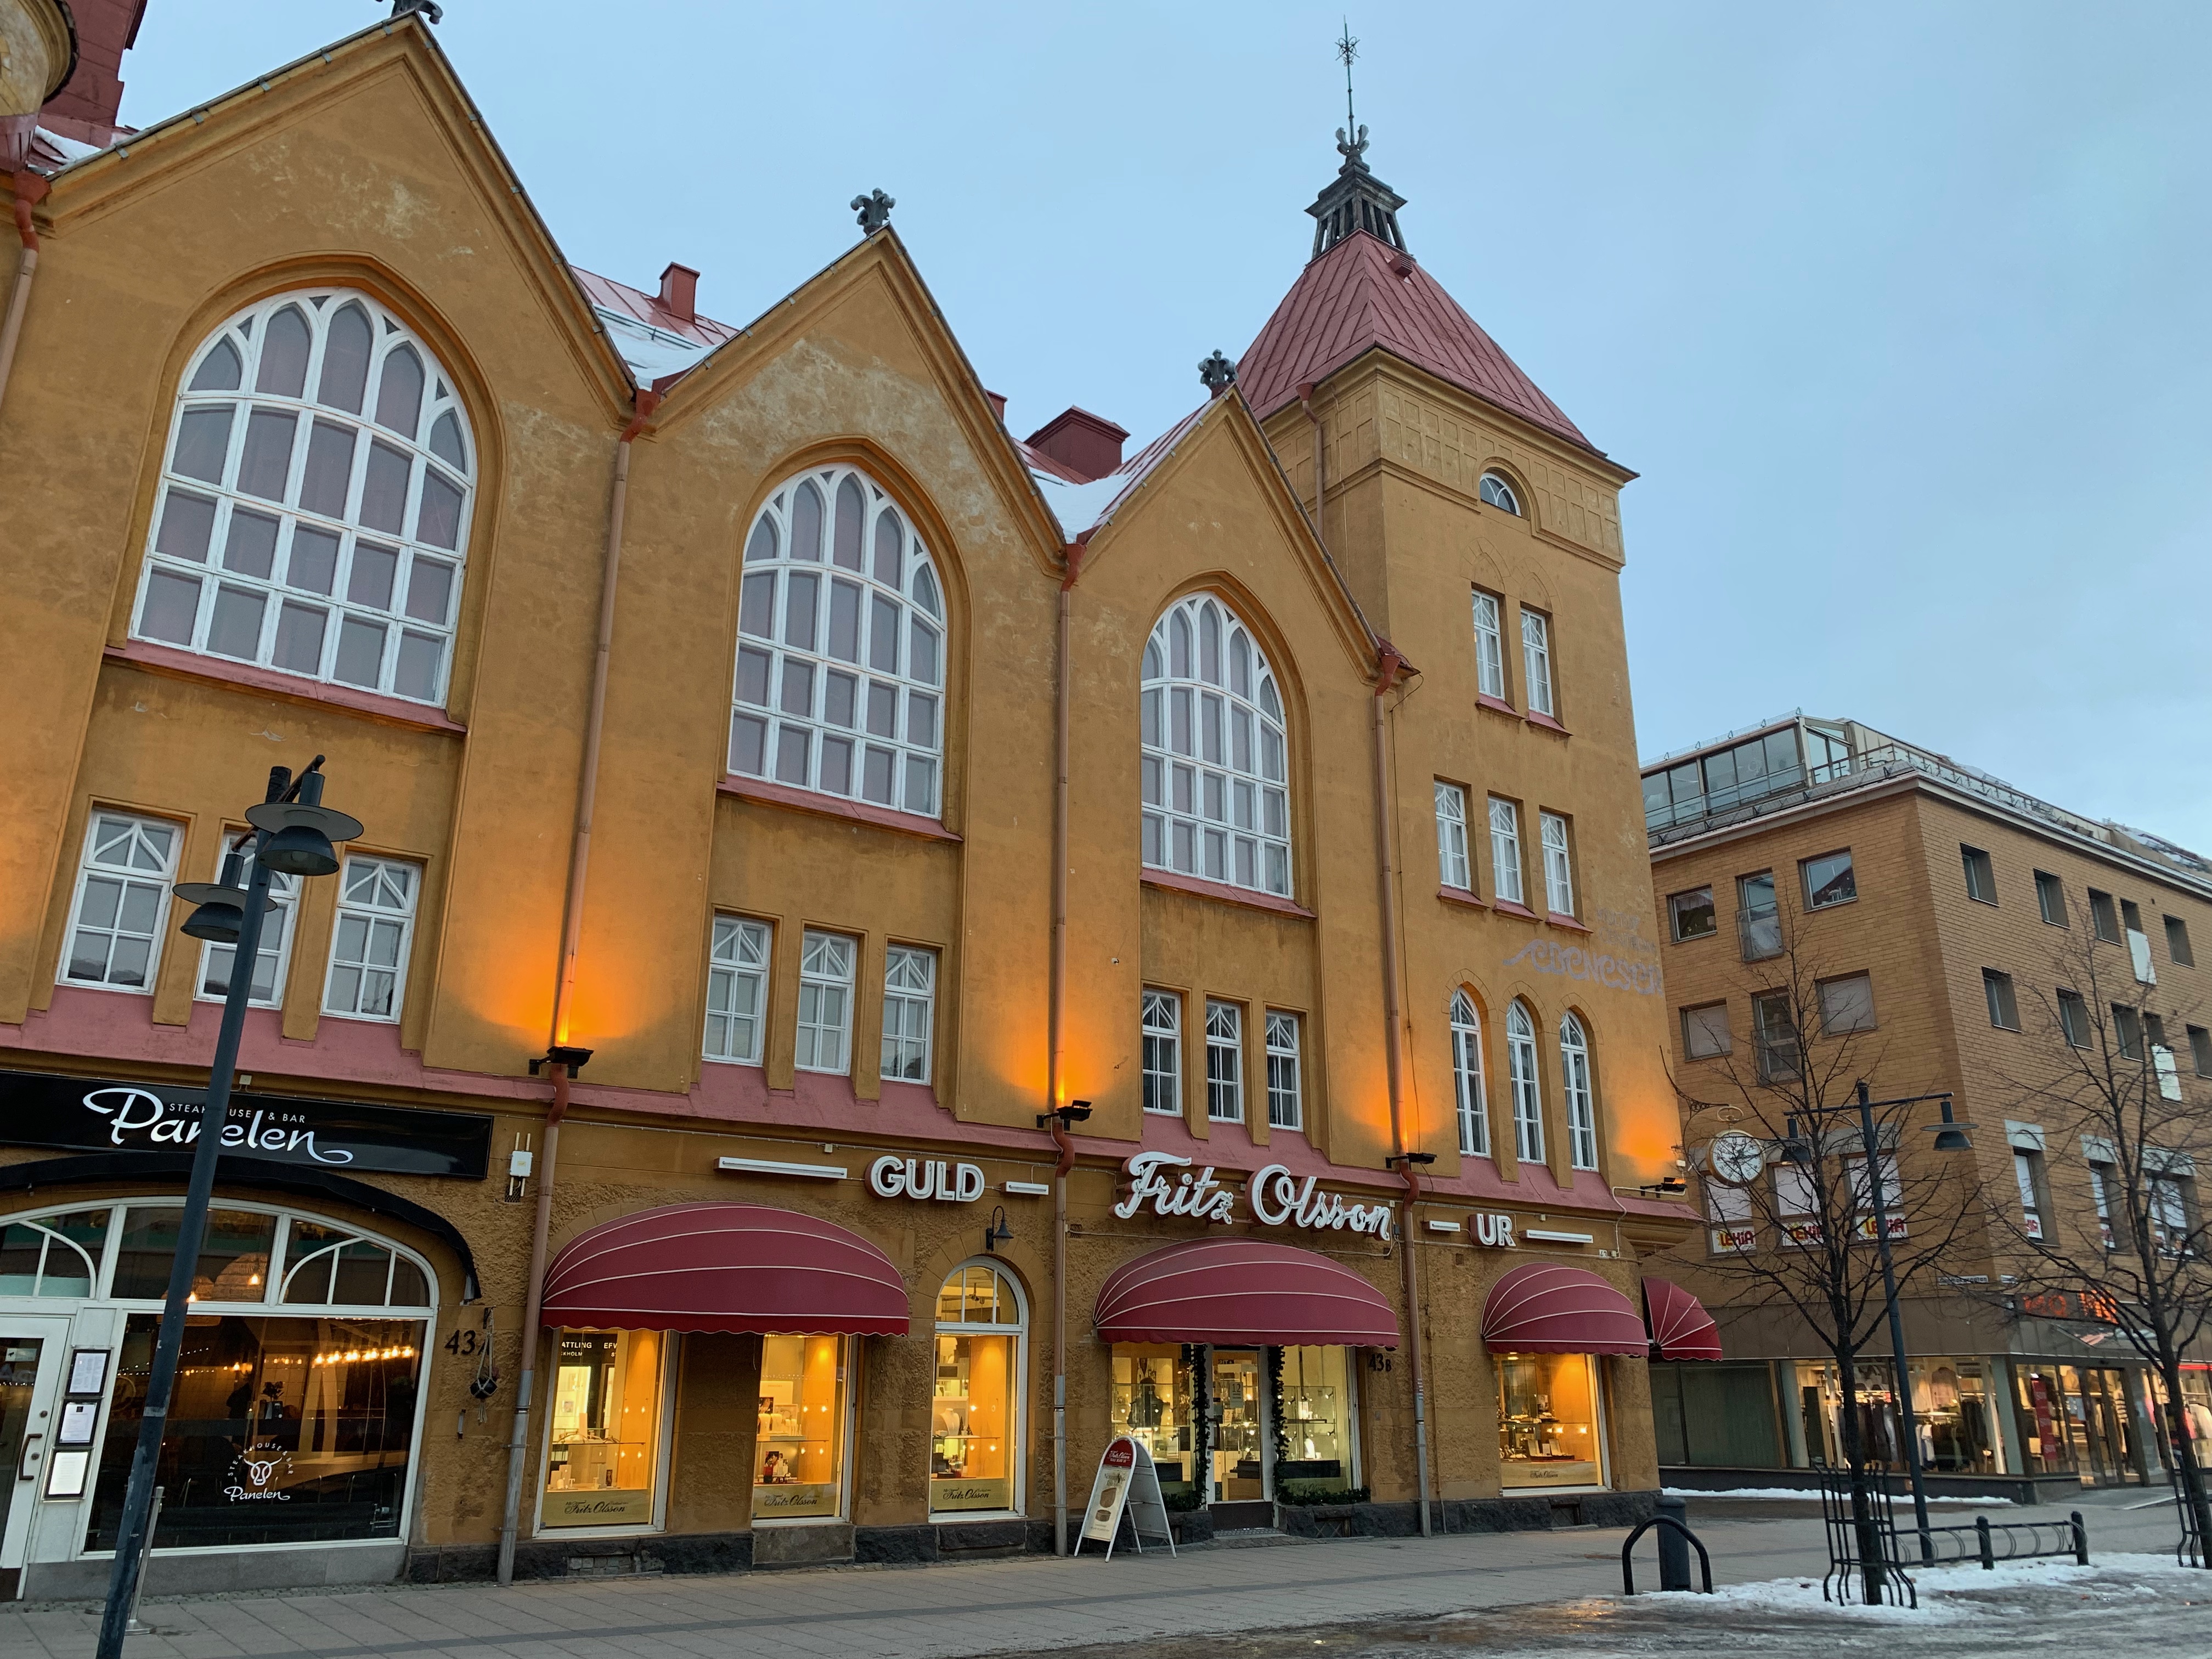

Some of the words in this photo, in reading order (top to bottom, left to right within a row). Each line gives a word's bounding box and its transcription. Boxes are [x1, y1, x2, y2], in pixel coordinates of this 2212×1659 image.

[268, 1111, 275, 1120] &
[282, 1113, 306, 1124] BAR
[870, 1155, 985, 1202] GULD
[1115, 1151, 1234, 1224] Fritz
[1251, 1164, 1391, 1241] Olsson
[1476, 1213, 1516, 1246] UR
[1232, 1383, 1241, 1392] 12
[223, 1486, 290, 1502] Panelen
